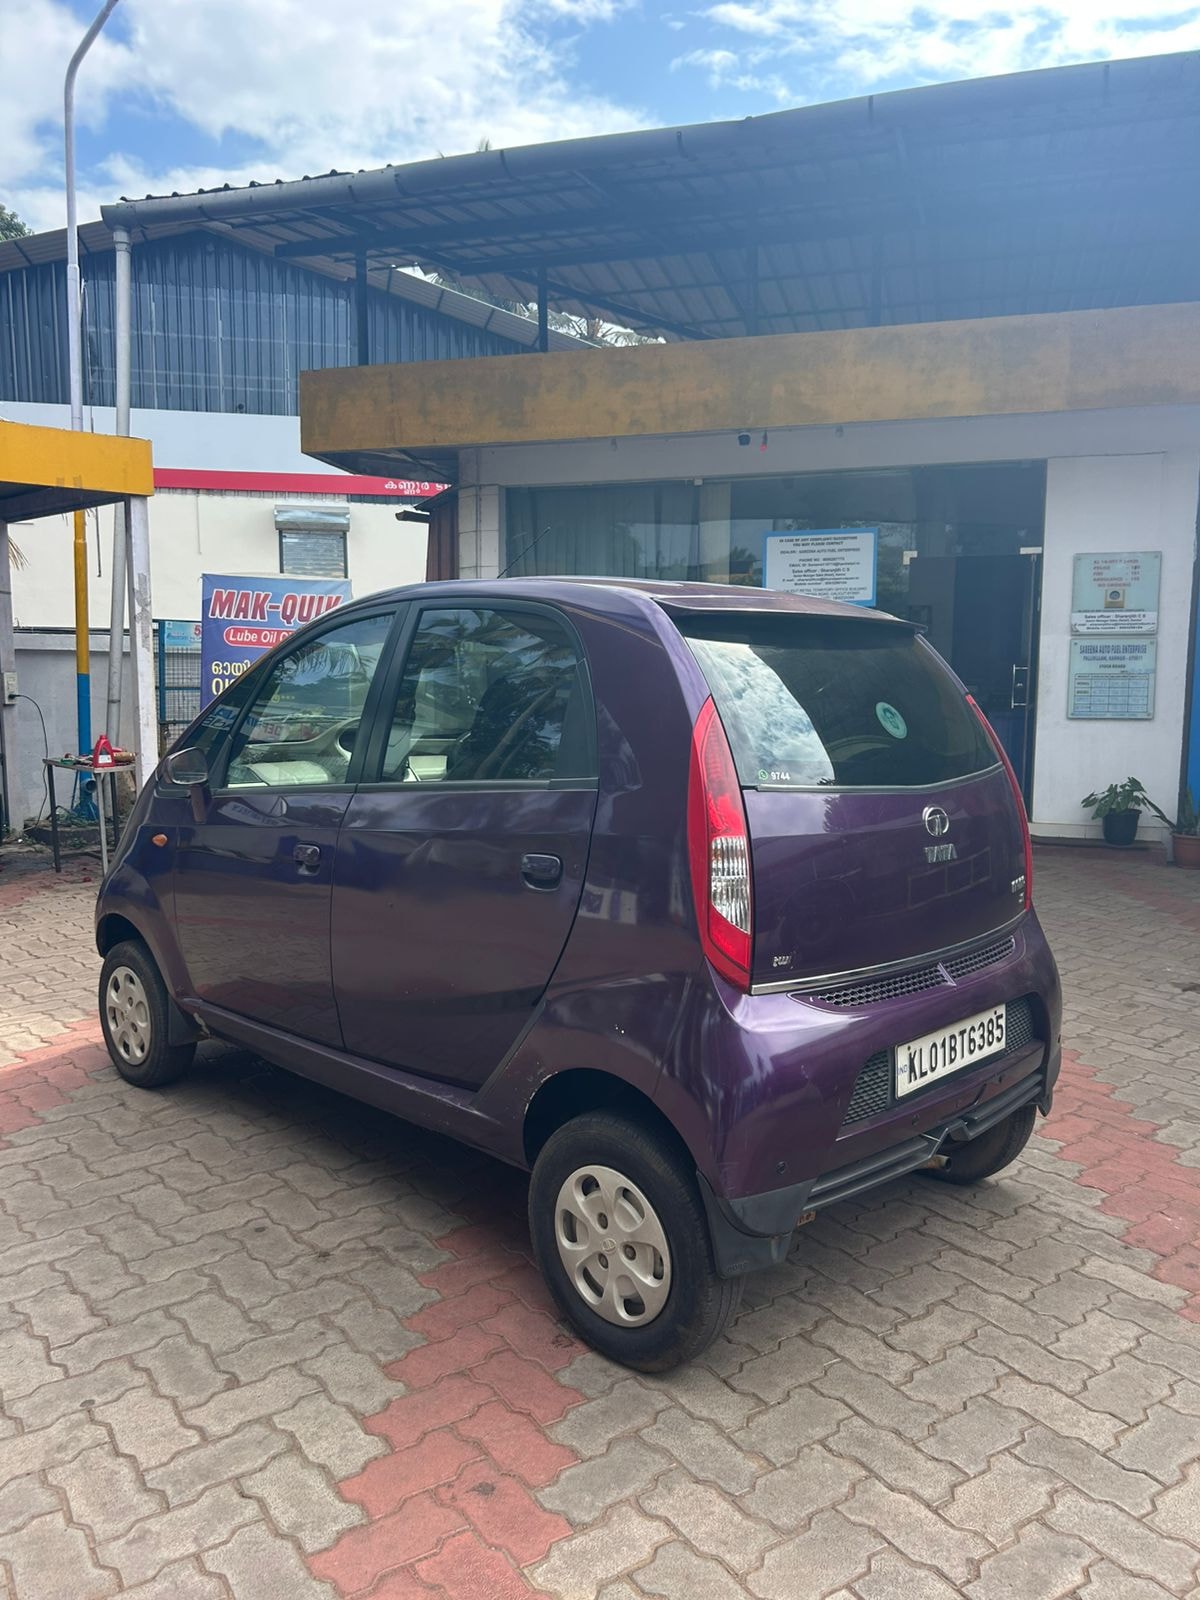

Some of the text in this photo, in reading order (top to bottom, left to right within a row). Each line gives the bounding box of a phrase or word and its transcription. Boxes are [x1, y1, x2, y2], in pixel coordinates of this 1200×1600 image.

[229, 629, 261, 643] Lube
[261, 630, 277, 644] Oil
[212, 660, 250, 676] ഓയി
[908, 1013, 1004, 1083] KL01BT6385
